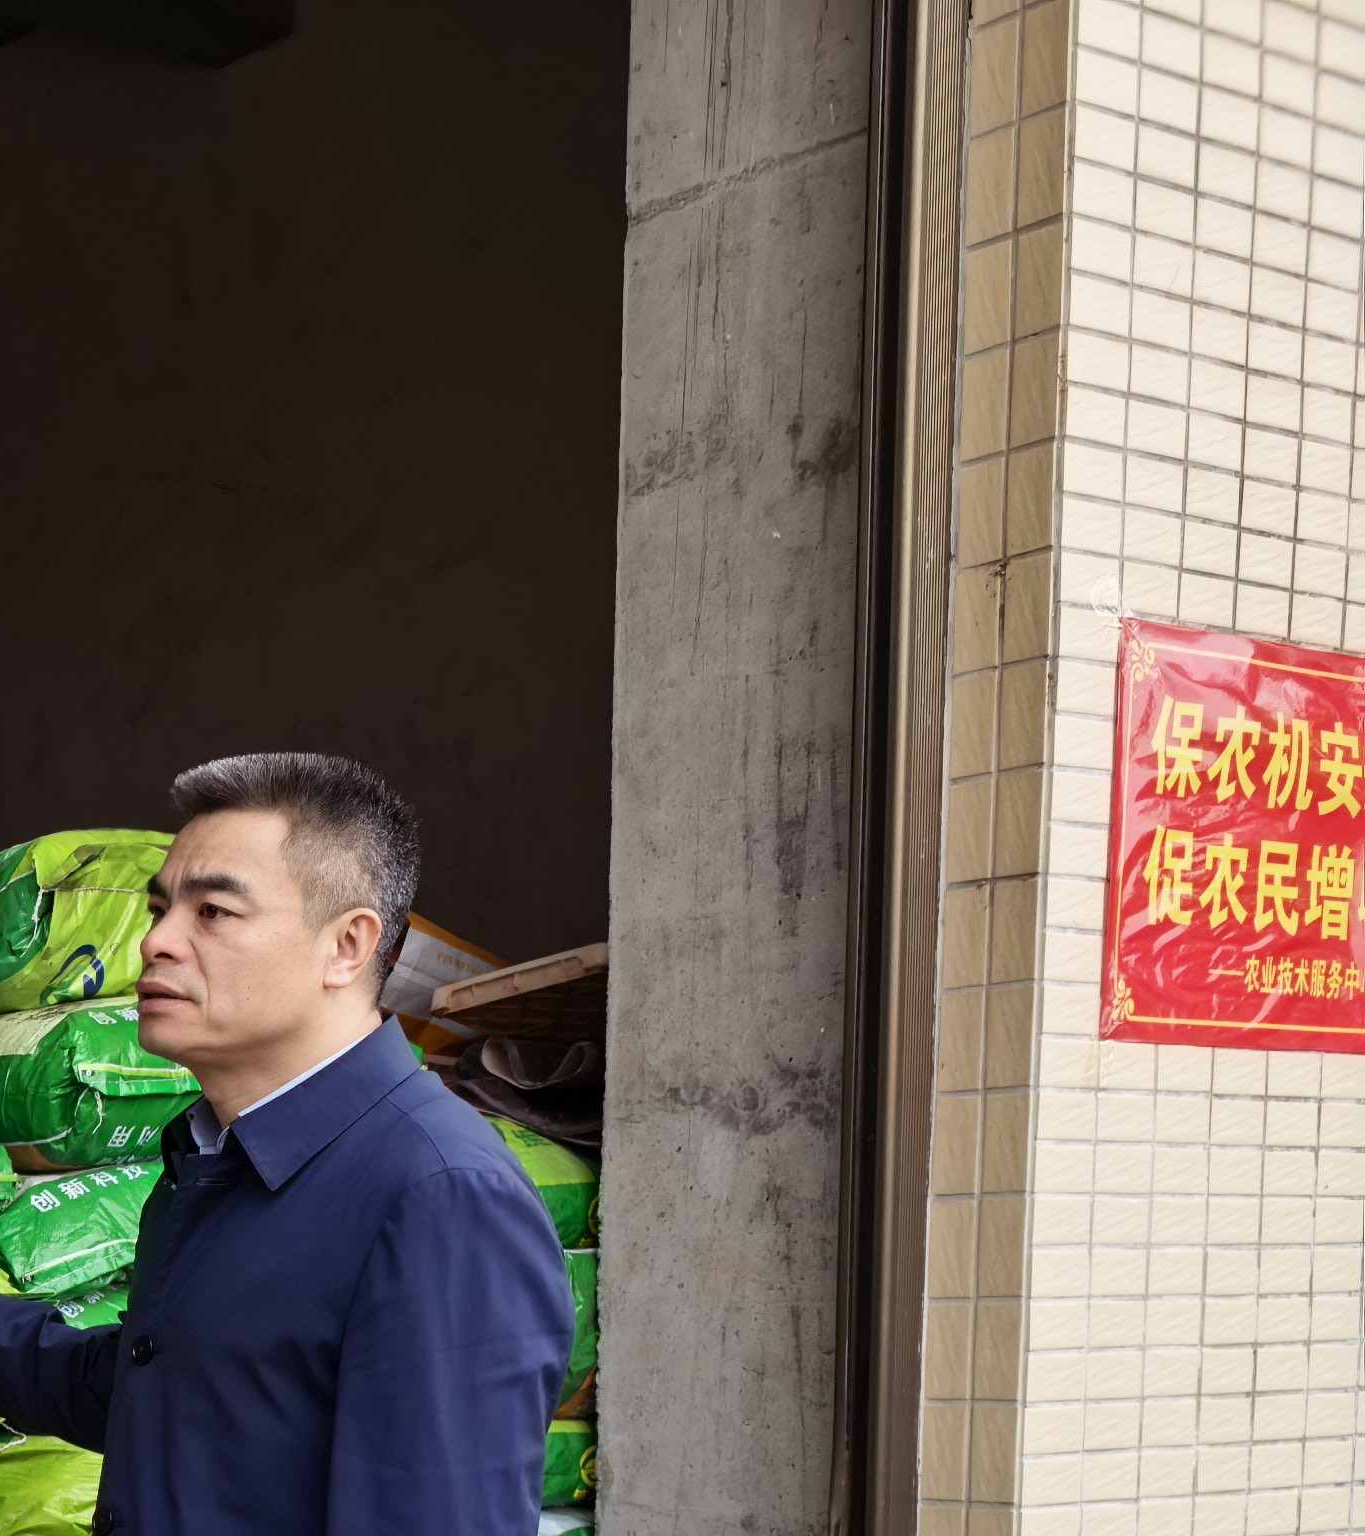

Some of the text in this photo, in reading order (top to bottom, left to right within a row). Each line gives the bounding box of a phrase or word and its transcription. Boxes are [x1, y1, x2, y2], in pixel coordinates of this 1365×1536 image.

[1150, 694, 1365, 820] 保农机安
[1143, 824, 1365, 942] 促农民增
[29, 1162, 150, 1215] 创新科技
